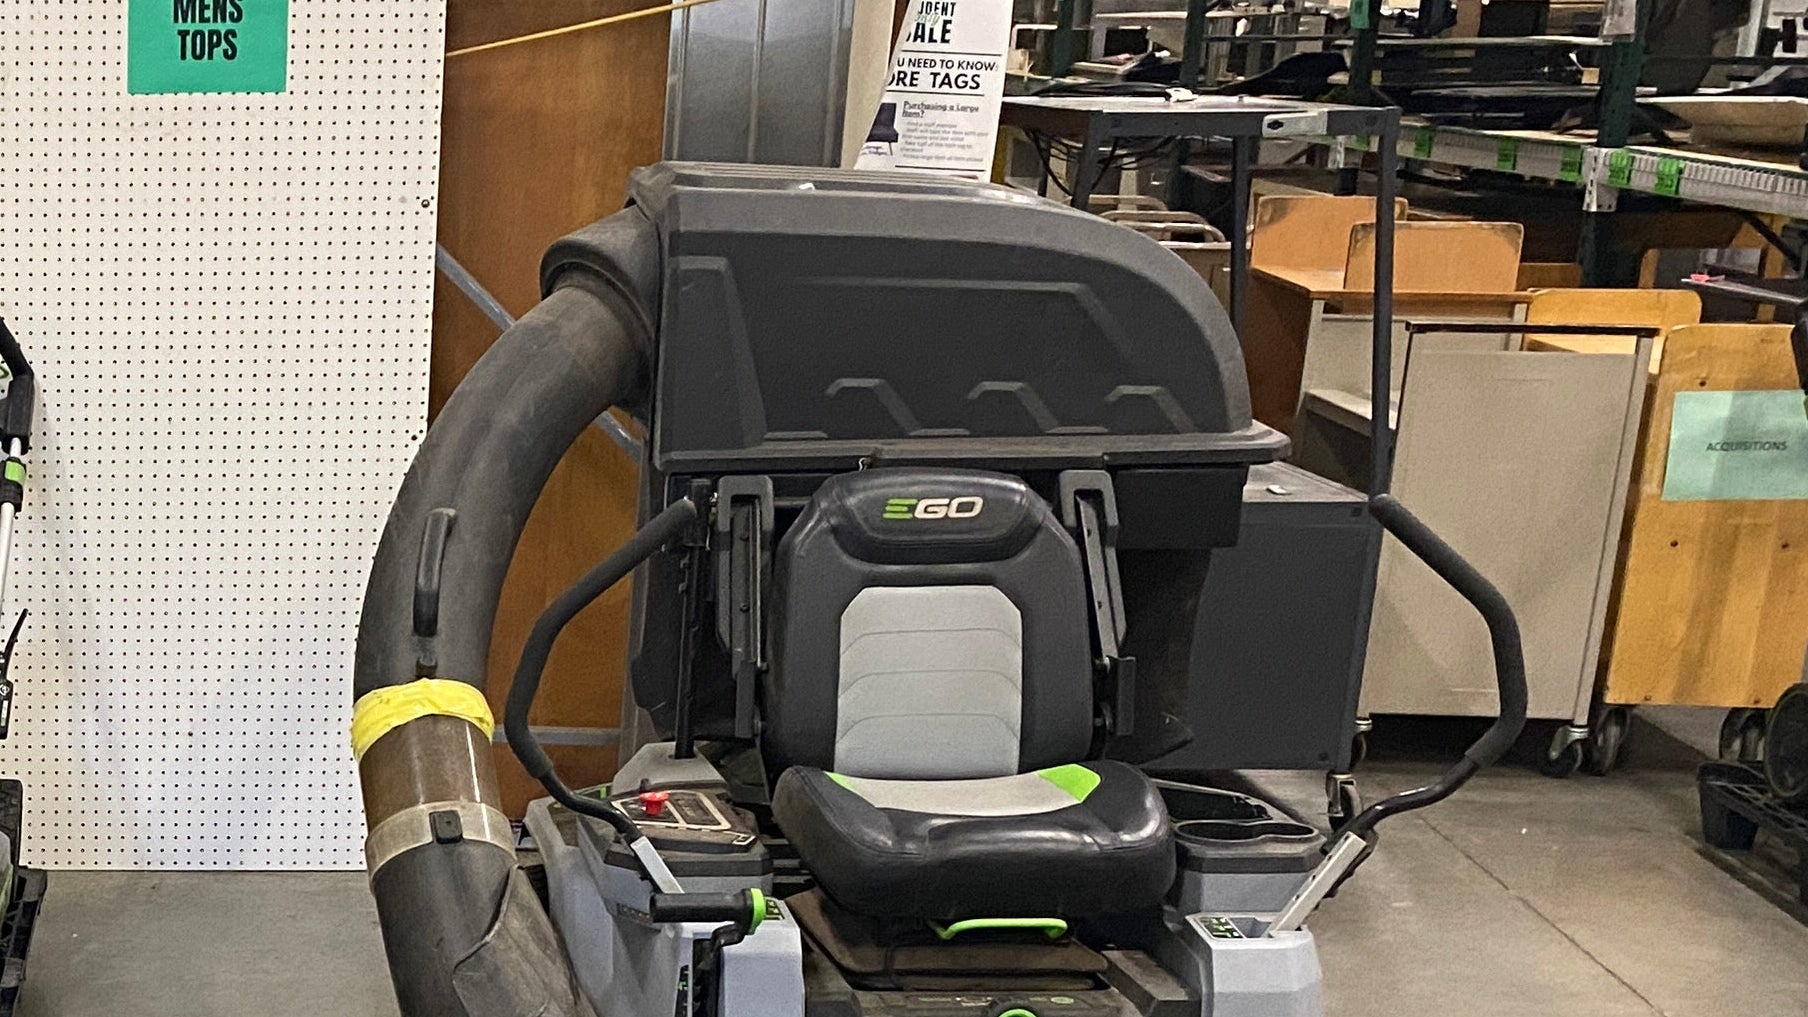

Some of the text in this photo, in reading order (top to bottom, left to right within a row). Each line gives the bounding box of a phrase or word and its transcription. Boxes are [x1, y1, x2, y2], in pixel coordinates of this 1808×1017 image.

[173, 0, 243, 23] MENS
[905, 19, 953, 43] ALE
[177, 29, 238, 61] TOPS
[908, 58, 937, 69] NEED
[939, 59, 954, 70] TO
[930, 72, 981, 90] TAGS
[1706, 440, 1788, 451] ACQUISITIONS
[882, 496, 984, 519] EGO
